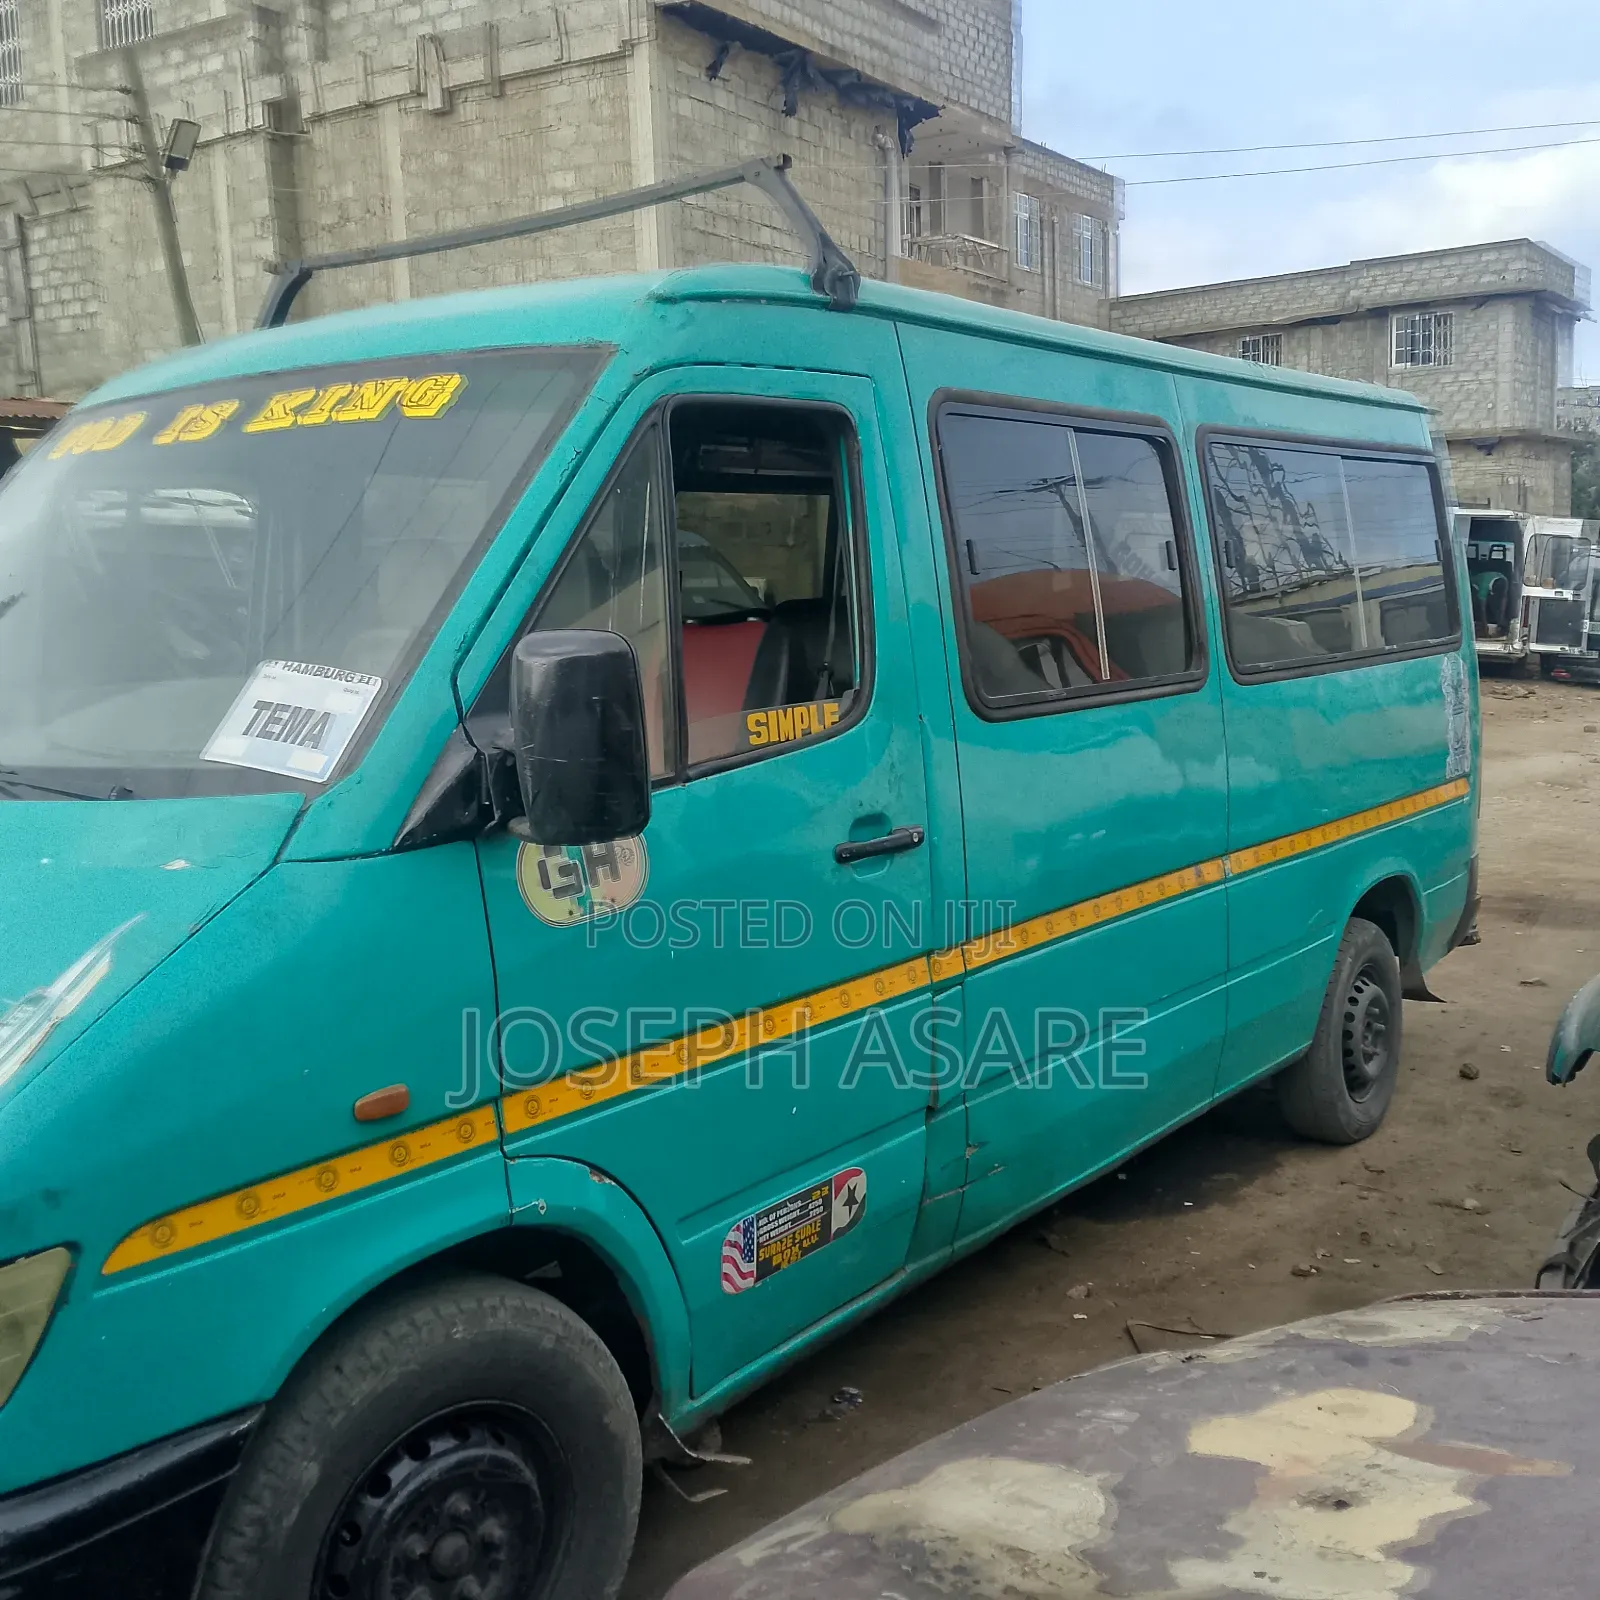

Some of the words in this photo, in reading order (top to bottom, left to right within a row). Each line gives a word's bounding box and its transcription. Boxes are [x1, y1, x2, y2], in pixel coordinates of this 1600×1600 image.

[152, 399, 241, 445] IS
[243, 372, 467, 433] KING
[281, 661, 356, 683] HAMBURG
[242, 699, 332, 750] TEMA
[746, 703, 840, 745] SIMPLE
[811, 1186, 830, 1201] 23
